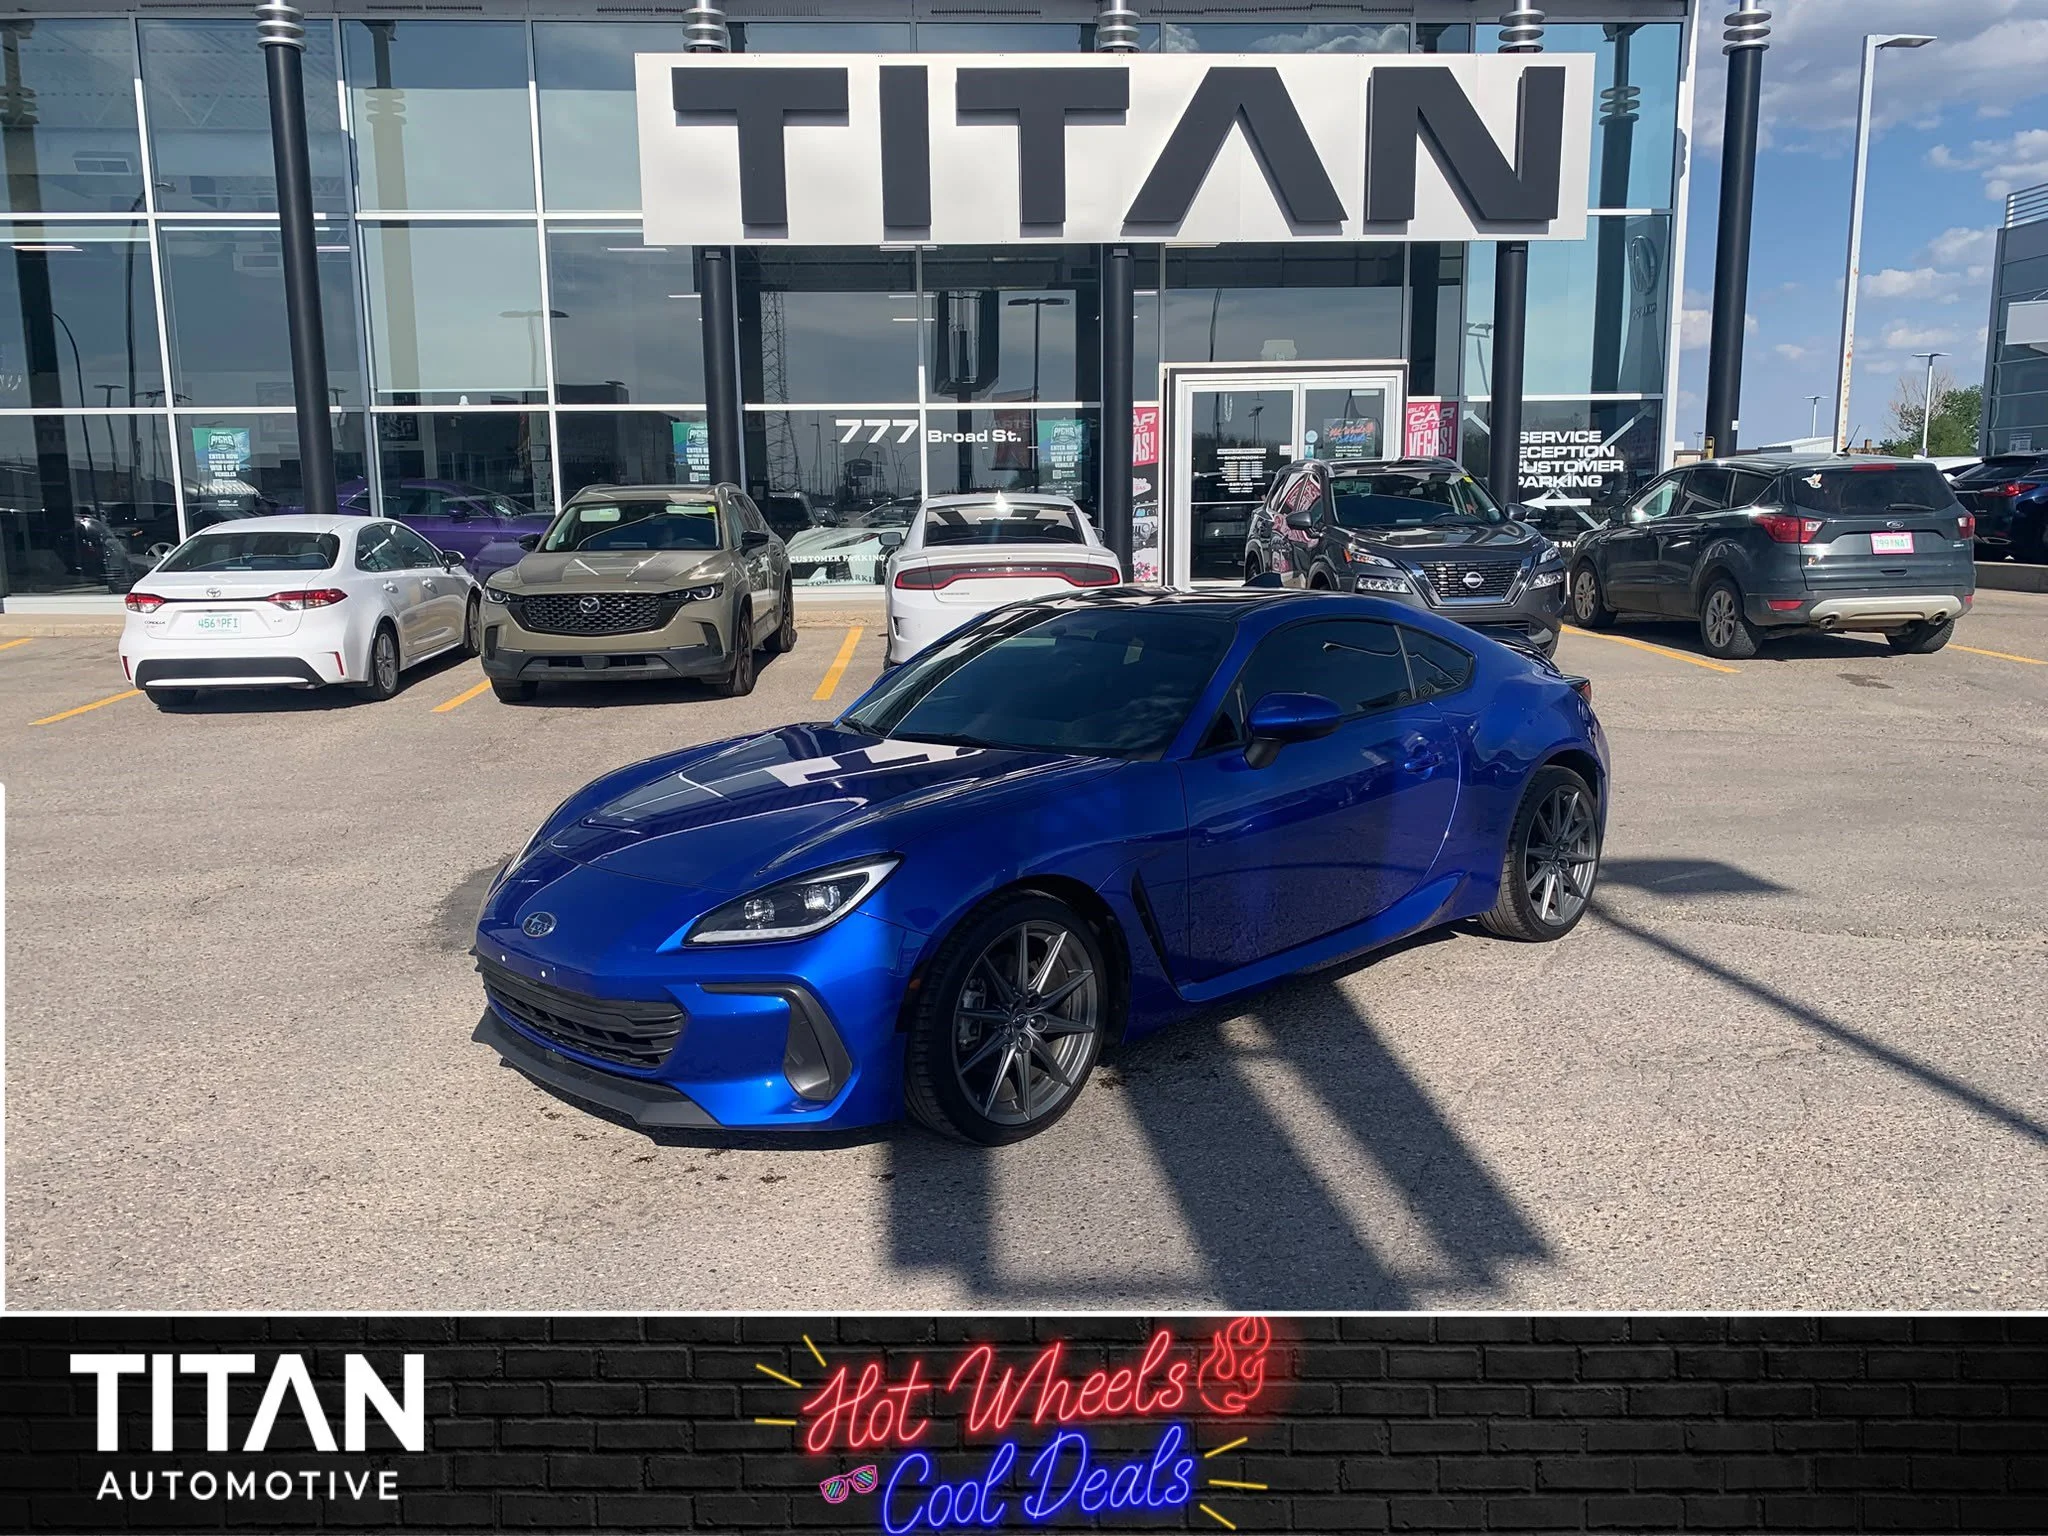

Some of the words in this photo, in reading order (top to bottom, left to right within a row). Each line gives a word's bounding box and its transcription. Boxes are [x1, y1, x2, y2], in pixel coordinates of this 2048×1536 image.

[671, 65, 1566, 235] TITAN
[1408, 406, 1427, 414] BUY
[1409, 407, 1454, 425] CAR
[835, 419, 919, 443] 777
[928, 429, 988, 443] Broad
[992, 429, 1022, 442] St.
[1411, 423, 1429, 432] GO
[1430, 420, 1446, 428] TO
[1408, 426, 1453, 457] VEGAS!
[1519, 430, 1602, 443] SERVICE
[789, 554, 841, 563] CUSTOMER
[198, 618, 216, 628] 456
